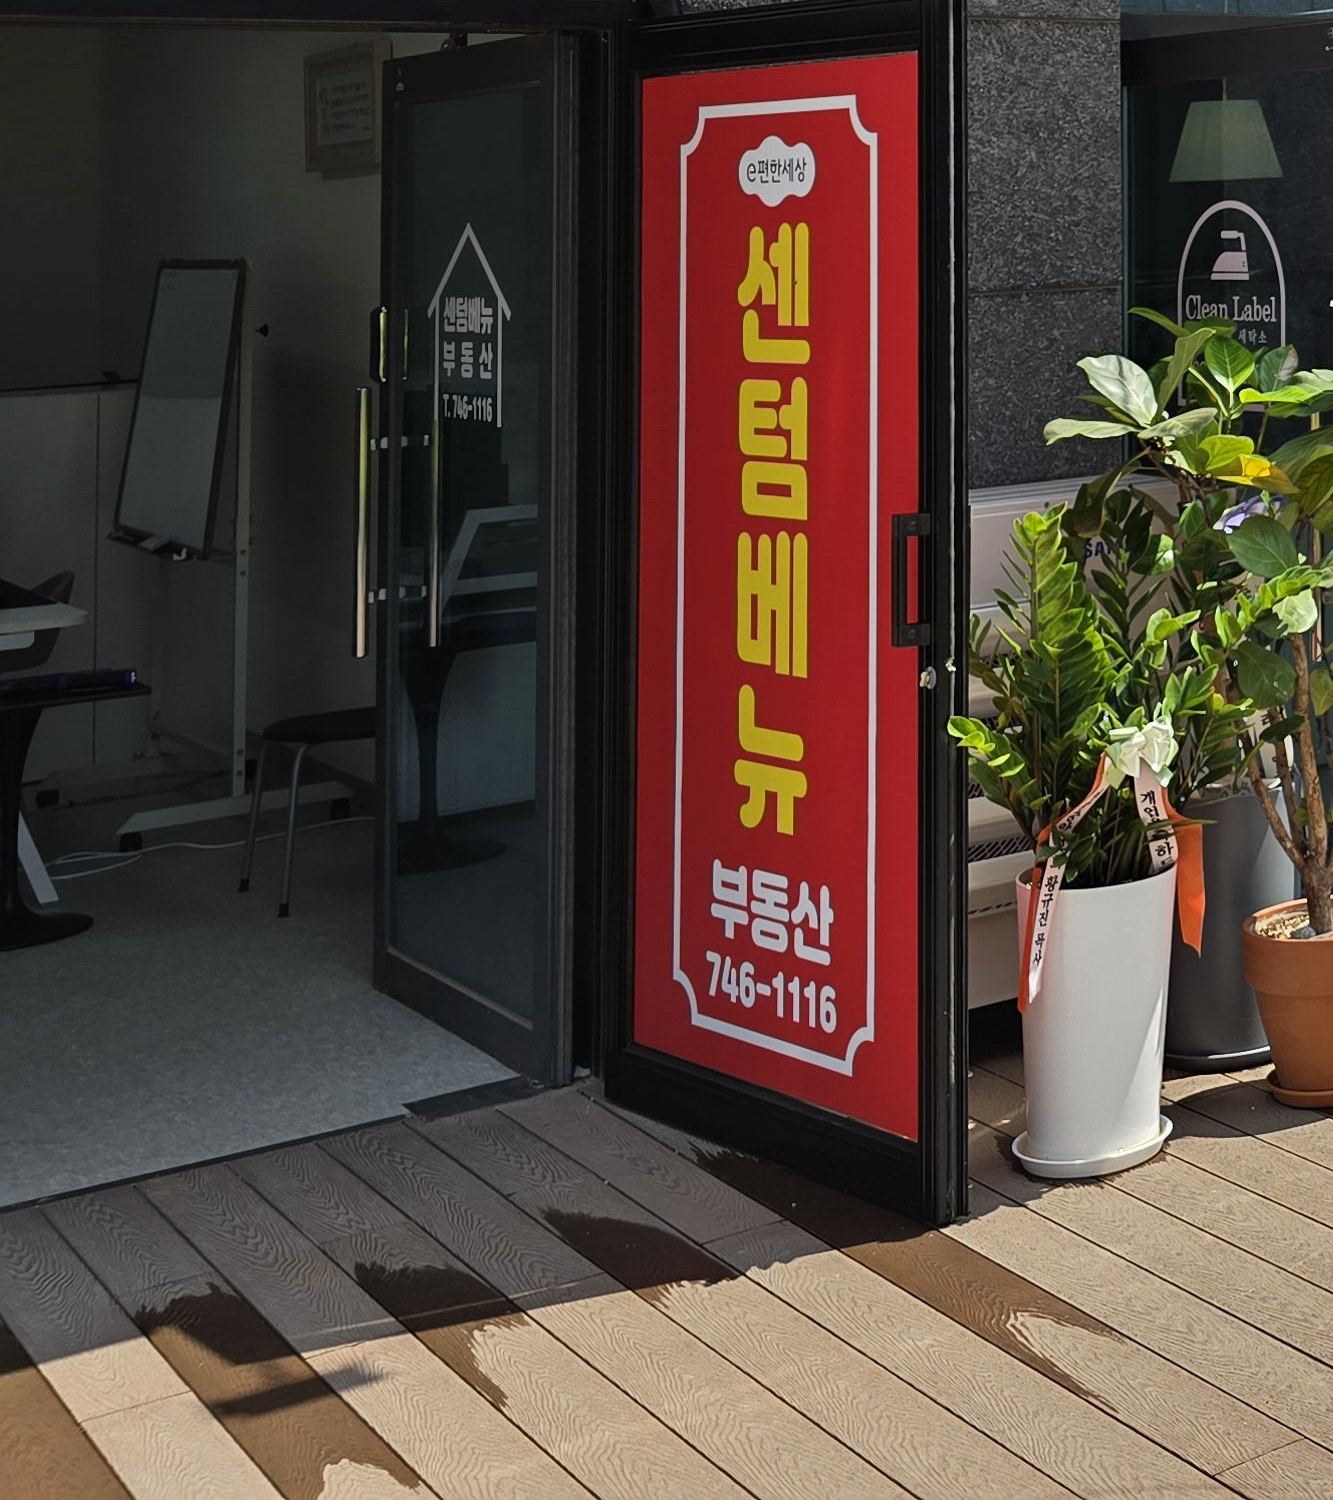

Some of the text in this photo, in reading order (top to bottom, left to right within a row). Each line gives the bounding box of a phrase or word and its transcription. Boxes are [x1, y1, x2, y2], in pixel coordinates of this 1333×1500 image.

[746, 156, 807, 184] e편한세상
[443, 296, 494, 335] 센텀베뉴
[1185, 294, 1277, 323] Clean Label
[1237, 328, 1268, 346] 세탁소
[442, 341, 494, 380] 부동산
[452, 394, 493, 423] 746-1116
[734, 221, 810, 836] 센텀베뉴
[709, 857, 836, 968] 부동산
[704, 950, 838, 1036] 746-1116
